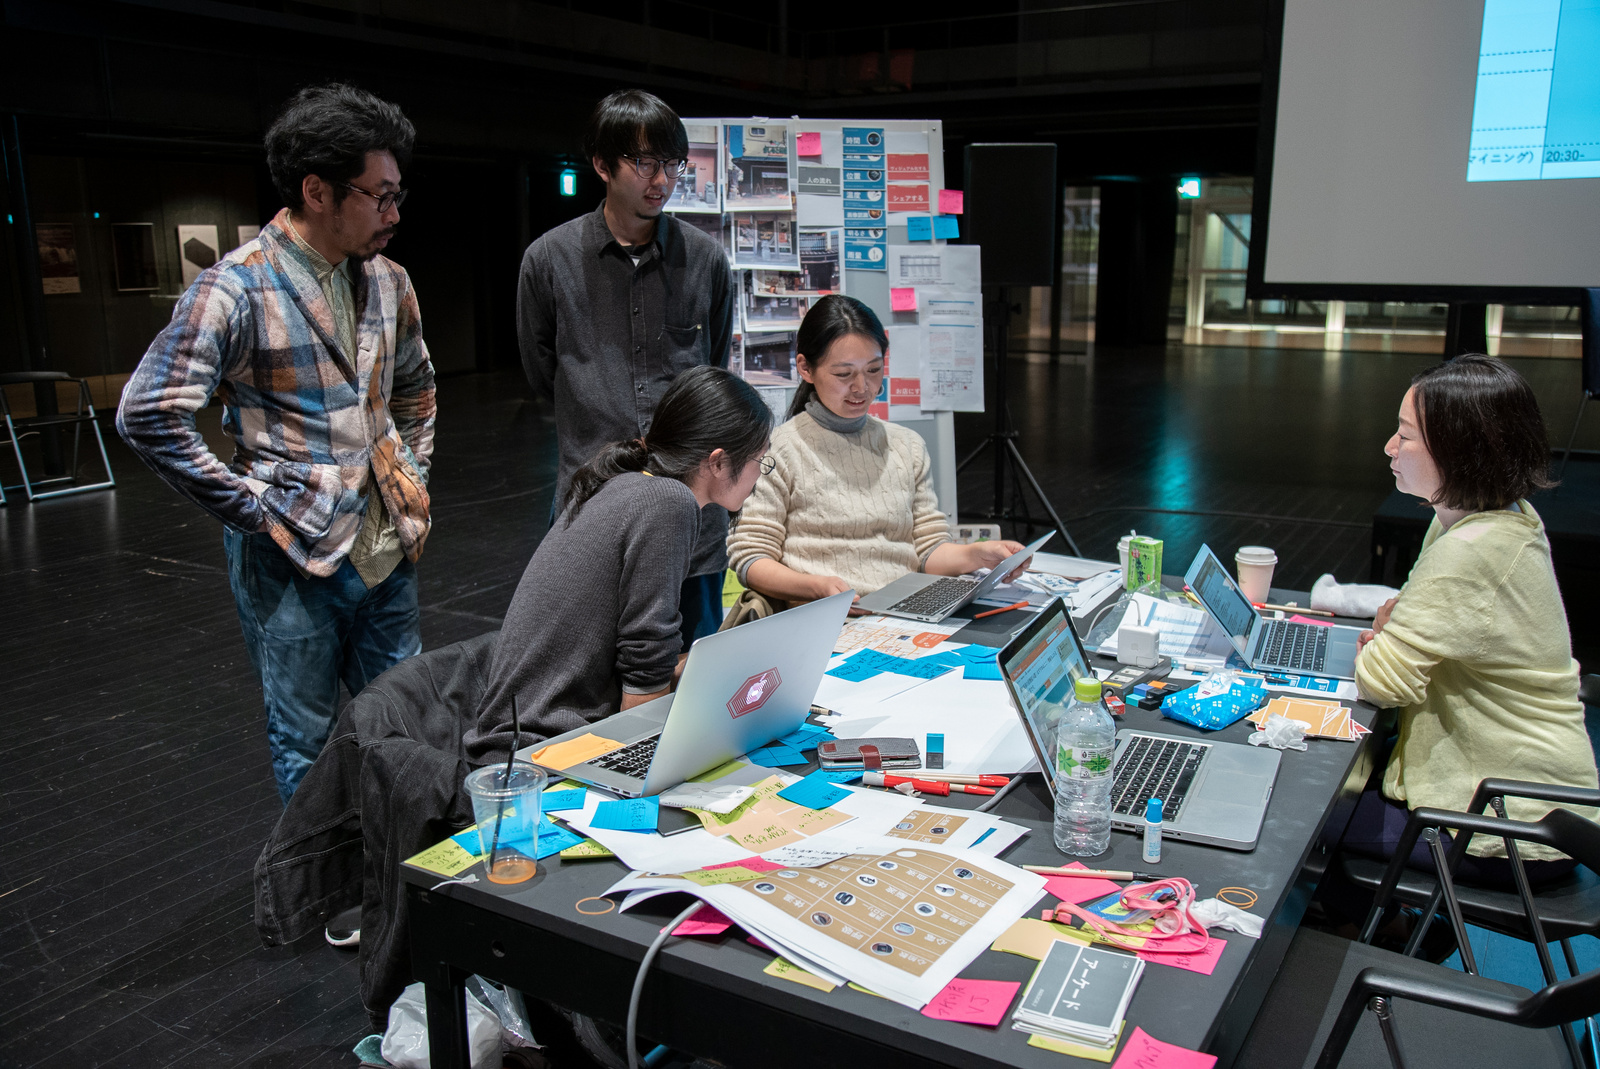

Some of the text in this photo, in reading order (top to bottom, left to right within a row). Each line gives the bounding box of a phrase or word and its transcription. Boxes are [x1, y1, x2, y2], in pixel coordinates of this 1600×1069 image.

[973, 876, 1004, 890] ストレス
[886, 886, 909, 900] 脳波
[783, 894, 805, 908] 体温
[841, 926, 864, 941] 呼吸
[1062, 958, 1099, 1011] アーケード
